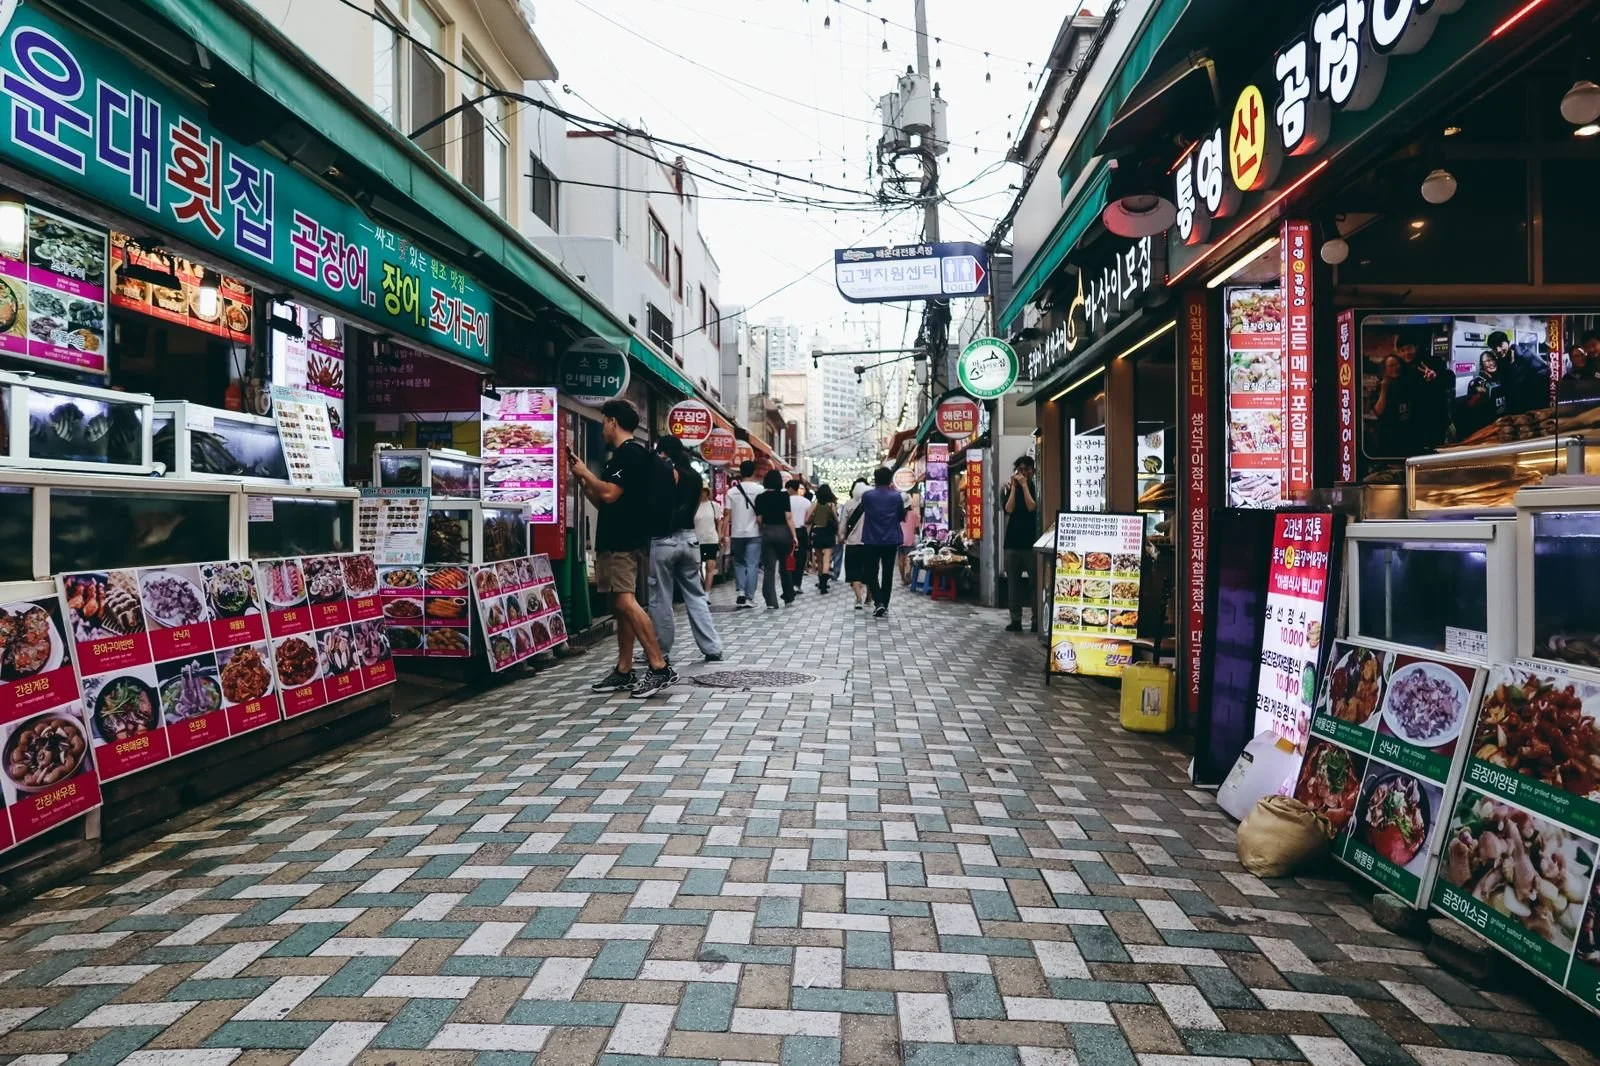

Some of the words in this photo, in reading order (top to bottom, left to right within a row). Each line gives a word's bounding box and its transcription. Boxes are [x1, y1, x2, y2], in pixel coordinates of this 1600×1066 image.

[0, 24, 276, 266] 운대횟집
[875, 246, 933, 258] 해운대전통시장
[841, 263, 938, 285] 고객지원센터
[1084, 235, 1152, 334] 마산이모집
[428, 285, 490, 358] 조개구이
[1290, 314, 1308, 350] 모든
[566, 374, 621, 390] 인테리어
[1290, 355, 1308, 390] 메뉴
[673, 410, 708, 424] 푸짐한
[943, 410, 973, 420] 해운대
[1290, 395, 1309, 484] 포장됩니다
[1191, 413, 1205, 494] 생선구이정식
[971, 463, 981, 498] 해운대
[1283, 518, 1303, 541] 28년
[1305, 517, 1322, 542] 전통
[172, 628, 191, 642] 산낙지
[1055, 649, 1077, 661] Kelly
[14, 677, 51, 699] 간장게장
[1378, 739, 1401, 759] 산낙지
[1471, 763, 1519, 796] 곰장어양념
[33, 783, 78, 811] 간장새우장
[1353, 848, 1375, 872] 해물탕
[1442, 888, 1489, 929] 곰장어소금
